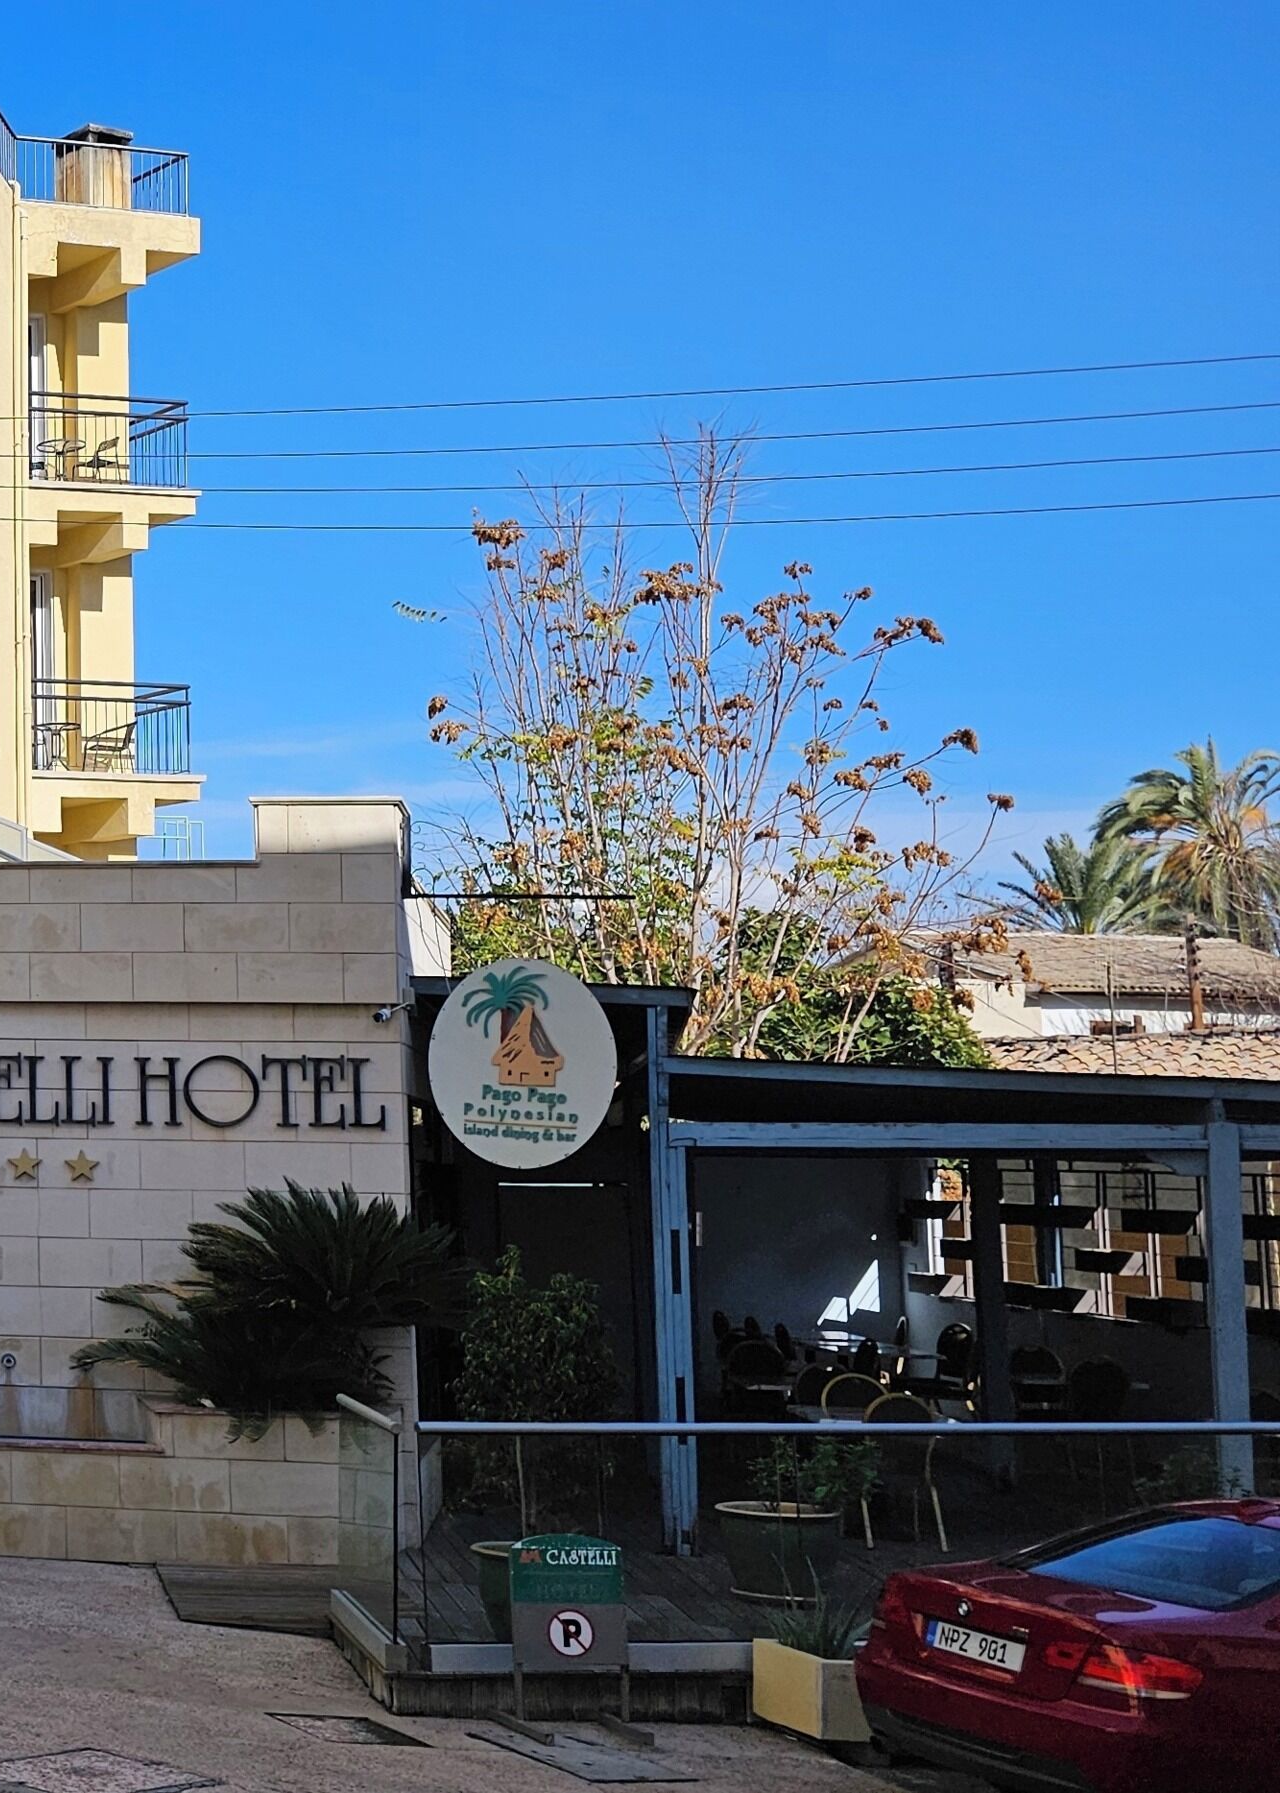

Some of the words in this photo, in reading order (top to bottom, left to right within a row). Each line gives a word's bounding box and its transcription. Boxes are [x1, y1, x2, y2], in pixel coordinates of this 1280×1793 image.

[134, 1054, 386, 1132] HOTEL
[482, 1085, 522, 1105] Pago
[528, 1088, 567, 1111] Pago
[464, 1103, 579, 1123] Polynesian
[464, 1123, 499, 1138] island
[502, 1126, 540, 1143] dining
[542, 1129, 554, 1142] &
[556, 1130, 577, 1142] bar
[546, 1549, 617, 1566] CASTELLI
[938, 1626, 971, 1653] NPZ
[978, 1637, 1007, 1664] 901
